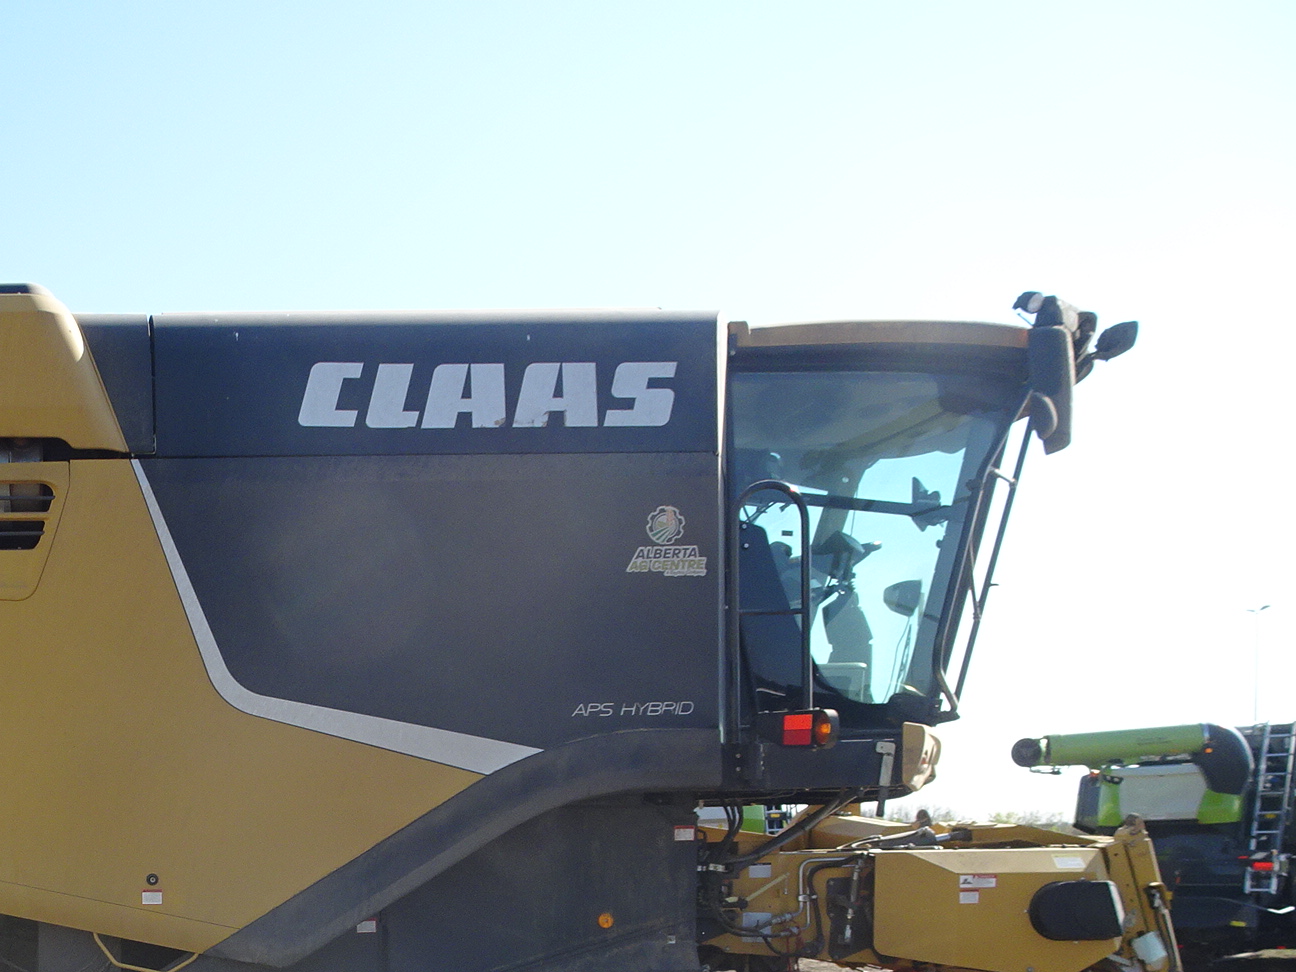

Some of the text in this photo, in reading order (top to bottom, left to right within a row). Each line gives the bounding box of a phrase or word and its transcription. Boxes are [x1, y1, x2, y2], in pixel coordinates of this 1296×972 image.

[298, 361, 678, 428] CLAAS
[635, 547, 698, 559] ALBERTA
[628, 559, 706, 572] AG CENTRE
[571, 701, 695, 717] APS HYBRID
